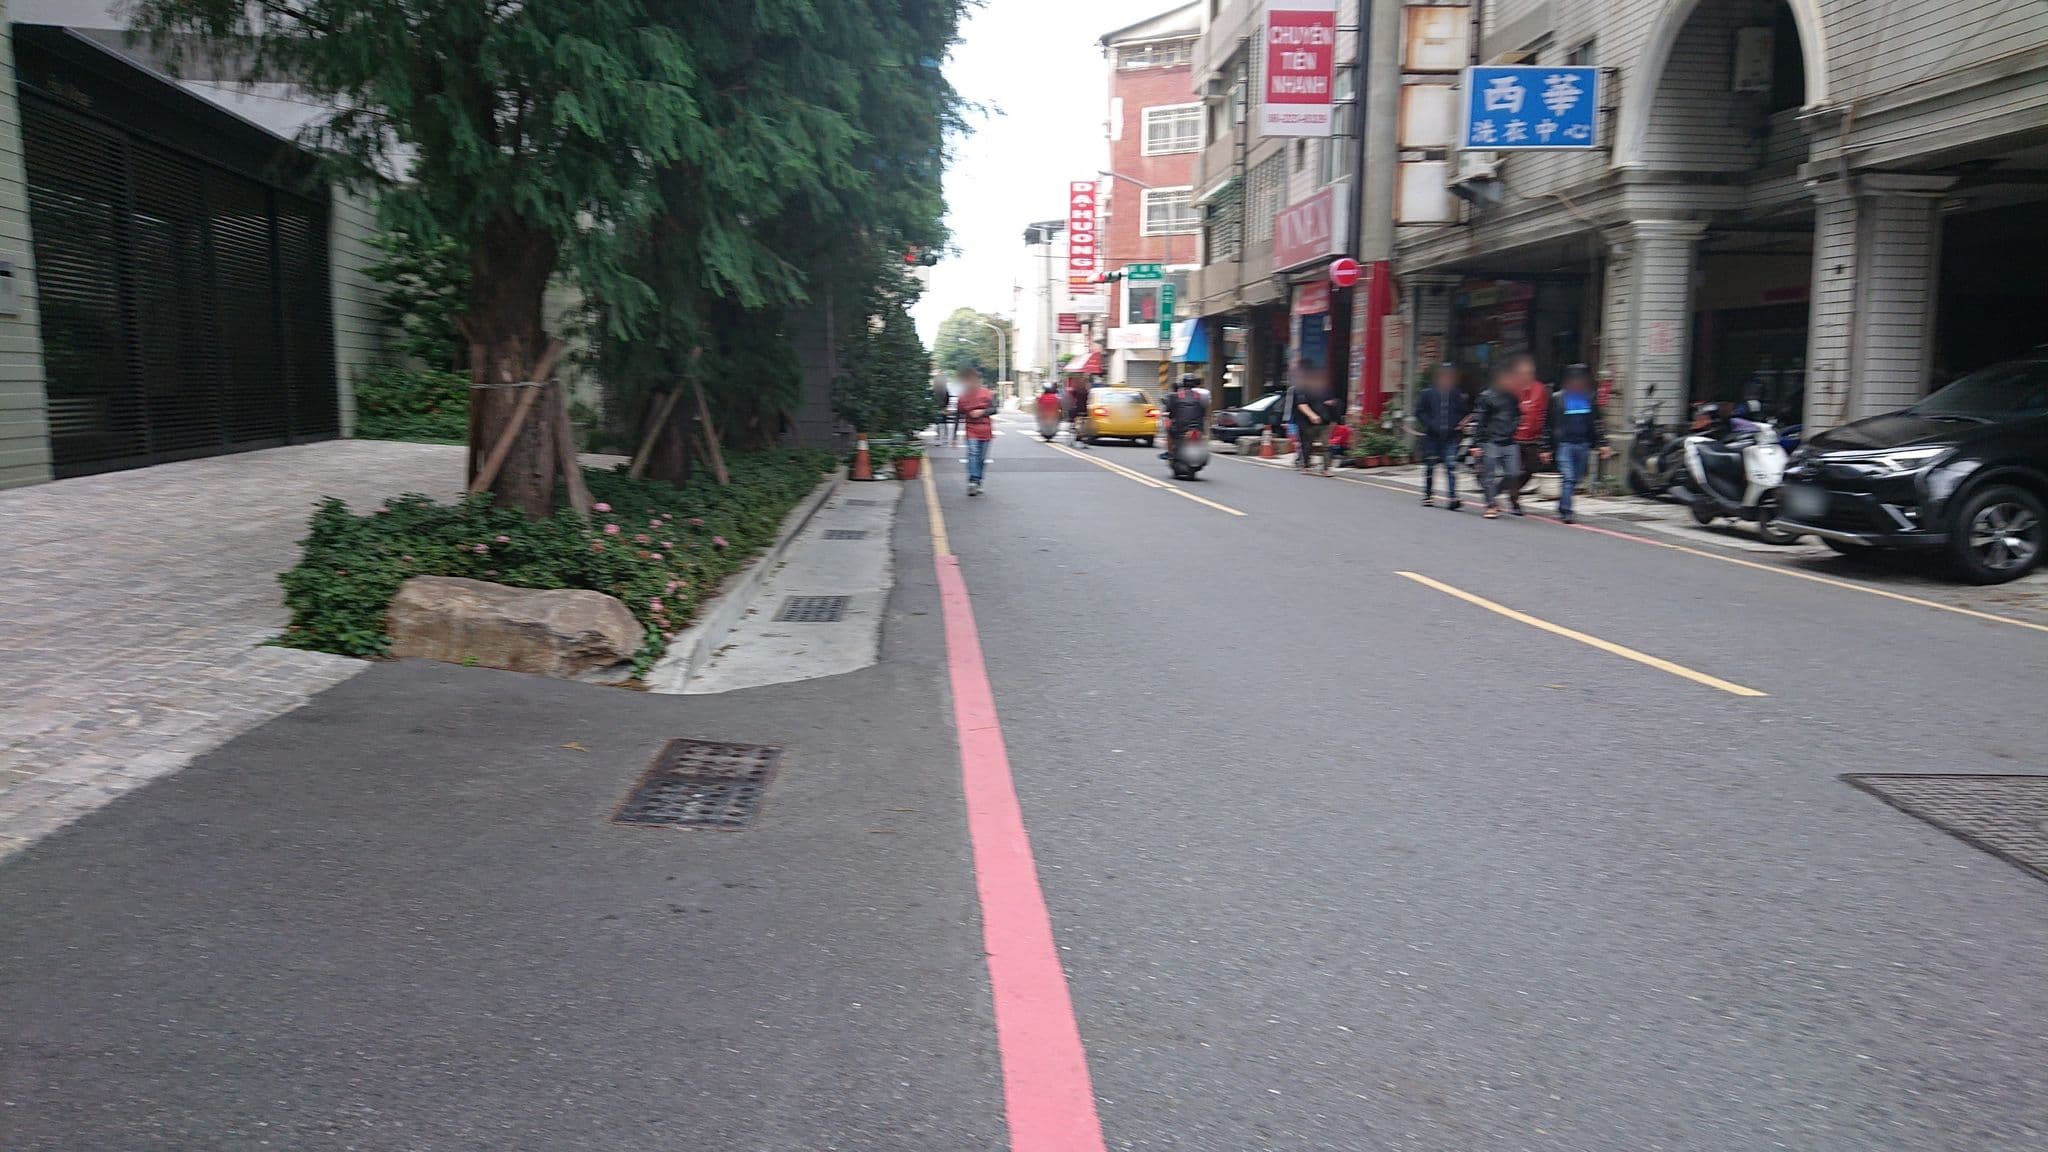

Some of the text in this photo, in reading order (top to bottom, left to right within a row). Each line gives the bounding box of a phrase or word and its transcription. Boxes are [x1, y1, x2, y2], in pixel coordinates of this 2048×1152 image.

[1271, 75, 1328, 94] NHANH
[1483, 74, 1584, 116] 西華
[1471, 119, 1591, 143] 洗衣中心
